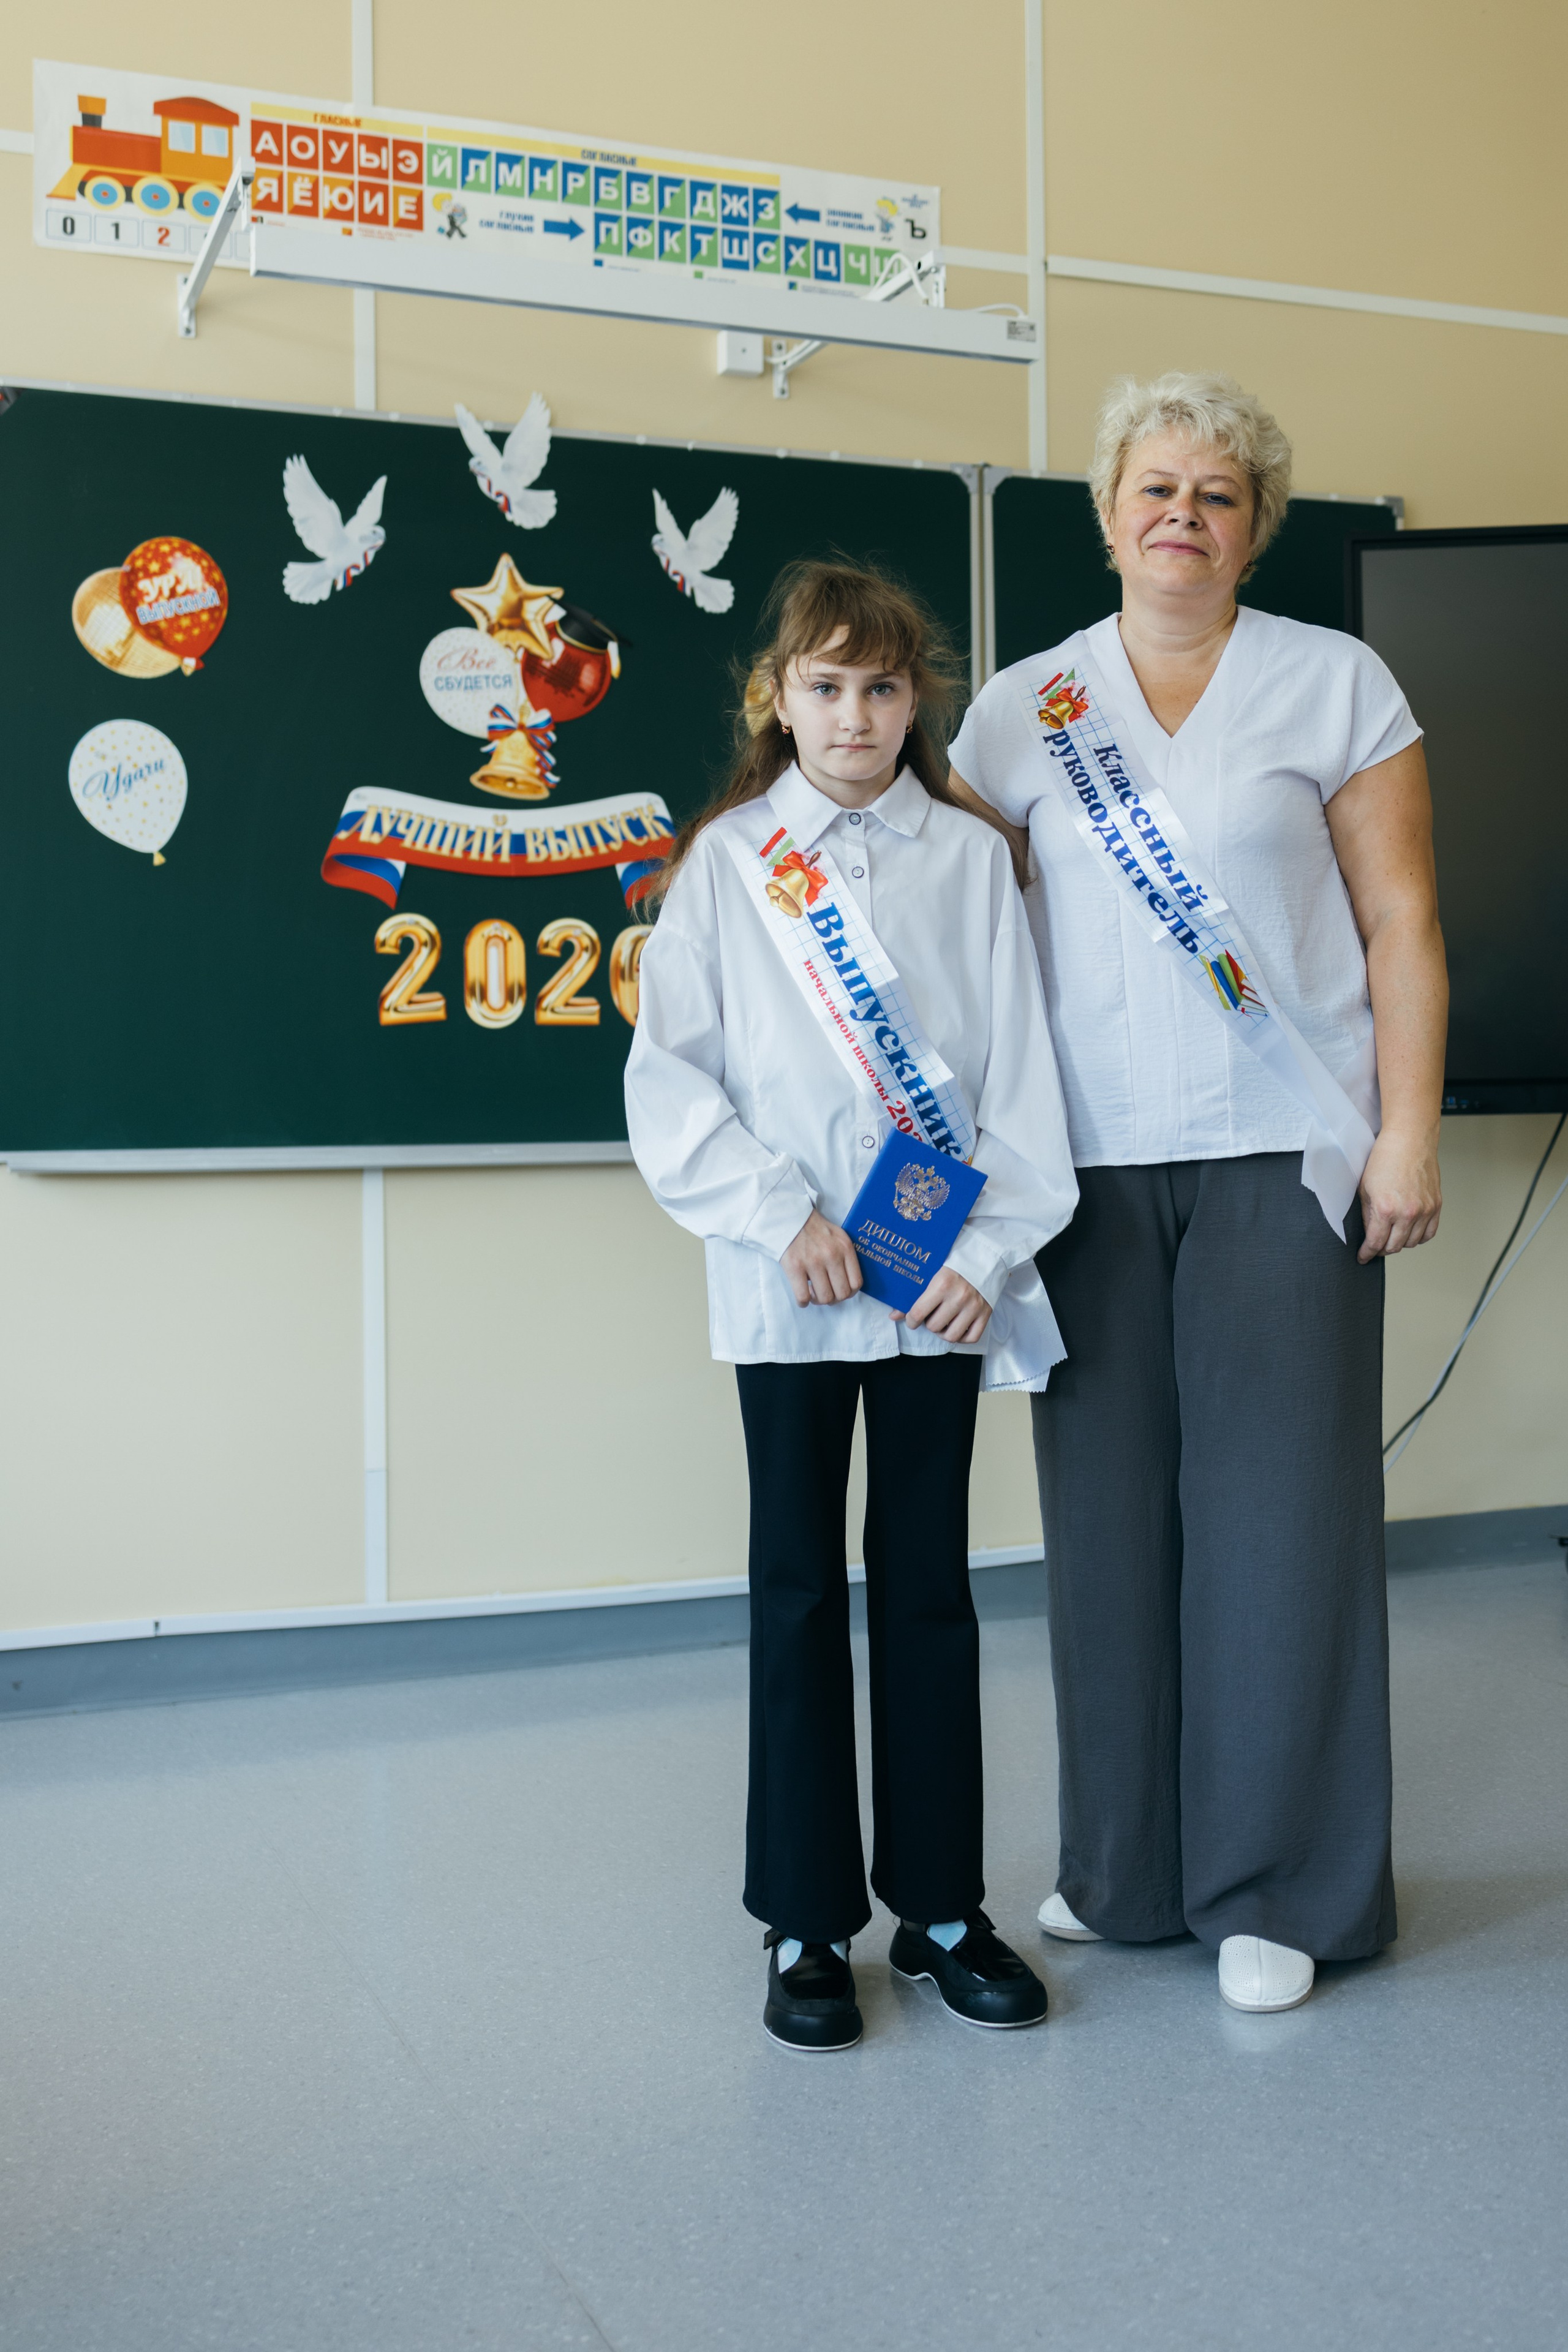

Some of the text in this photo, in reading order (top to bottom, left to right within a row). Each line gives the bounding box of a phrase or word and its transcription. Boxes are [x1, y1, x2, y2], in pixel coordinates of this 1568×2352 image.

[255, 130, 419, 174] А О У Ы Э
[256, 176, 418, 221] Я Ё Ю И Е
[432, 148, 775, 221] Й Л М Н Р Б В Г Д Ж З
[63, 217, 170, 246] 0 1 2
[598, 221, 619, 246] П
[628, 225, 654, 249] Ф
[664, 228, 681, 253] К
[694, 232, 714, 257] Т
[723, 236, 749, 261] Ш
[756, 241, 777, 264] С
[788, 244, 807, 268] Х
[816, 248, 837, 276] Ц
[848, 252, 867, 276] Ч
[905, 218, 927, 239] Ъ
[136, 587, 221, 625] ВЫПУСКНОЙ
[434, 674, 513, 692] СБУДЕТСЯ
[337, 804, 673, 862] ЛУЧШИЙ ВЫПУСК
[1042, 729, 1199, 954] руководитель
[1093, 743, 1208, 913] Классный
[804, 960, 858, 1044] начальной
[853, 1046, 889, 1101] школы
[806, 902, 961, 1156] Выпускник
[858, 1219, 931, 1264] ДИПЛОМ
[858, 1236, 919, 1272] ОБ ОКОНЧАНИИ
[893, 1264, 924, 1284] ШКОЛЫ
